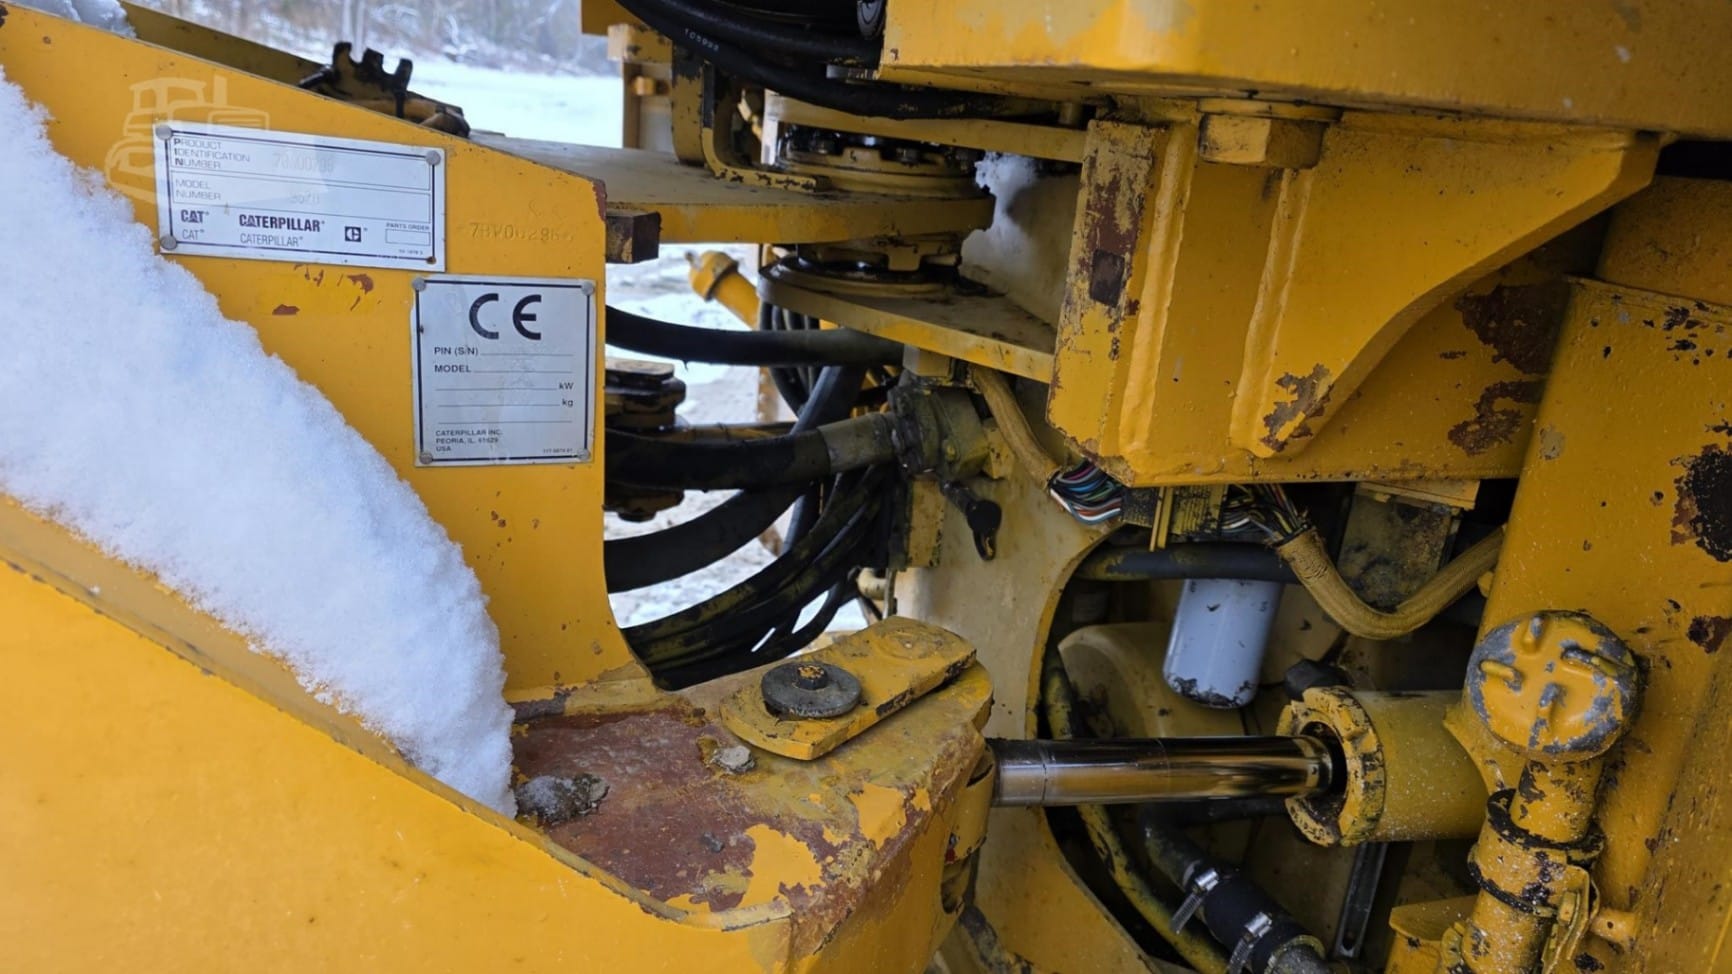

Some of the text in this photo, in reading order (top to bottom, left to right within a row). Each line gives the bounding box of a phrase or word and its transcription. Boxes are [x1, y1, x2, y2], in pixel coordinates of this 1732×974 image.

[173, 138, 222, 150] PRODUCT
[173, 147, 251, 162] IDENTIFICATION
[175, 158, 221, 169] NUMBER
[175, 179, 211, 190] MODEL
[175, 190, 221, 201] NUMBER
[386, 222, 430, 231] PARTS ORDER
[468, 292, 543, 341] CE
[434, 346, 479, 357] PIN (S/N)
[434, 364, 472, 374] MODEL
[558, 381, 574, 390] kW
[562, 398, 574, 408] kg
[435, 445, 452, 453] USA
